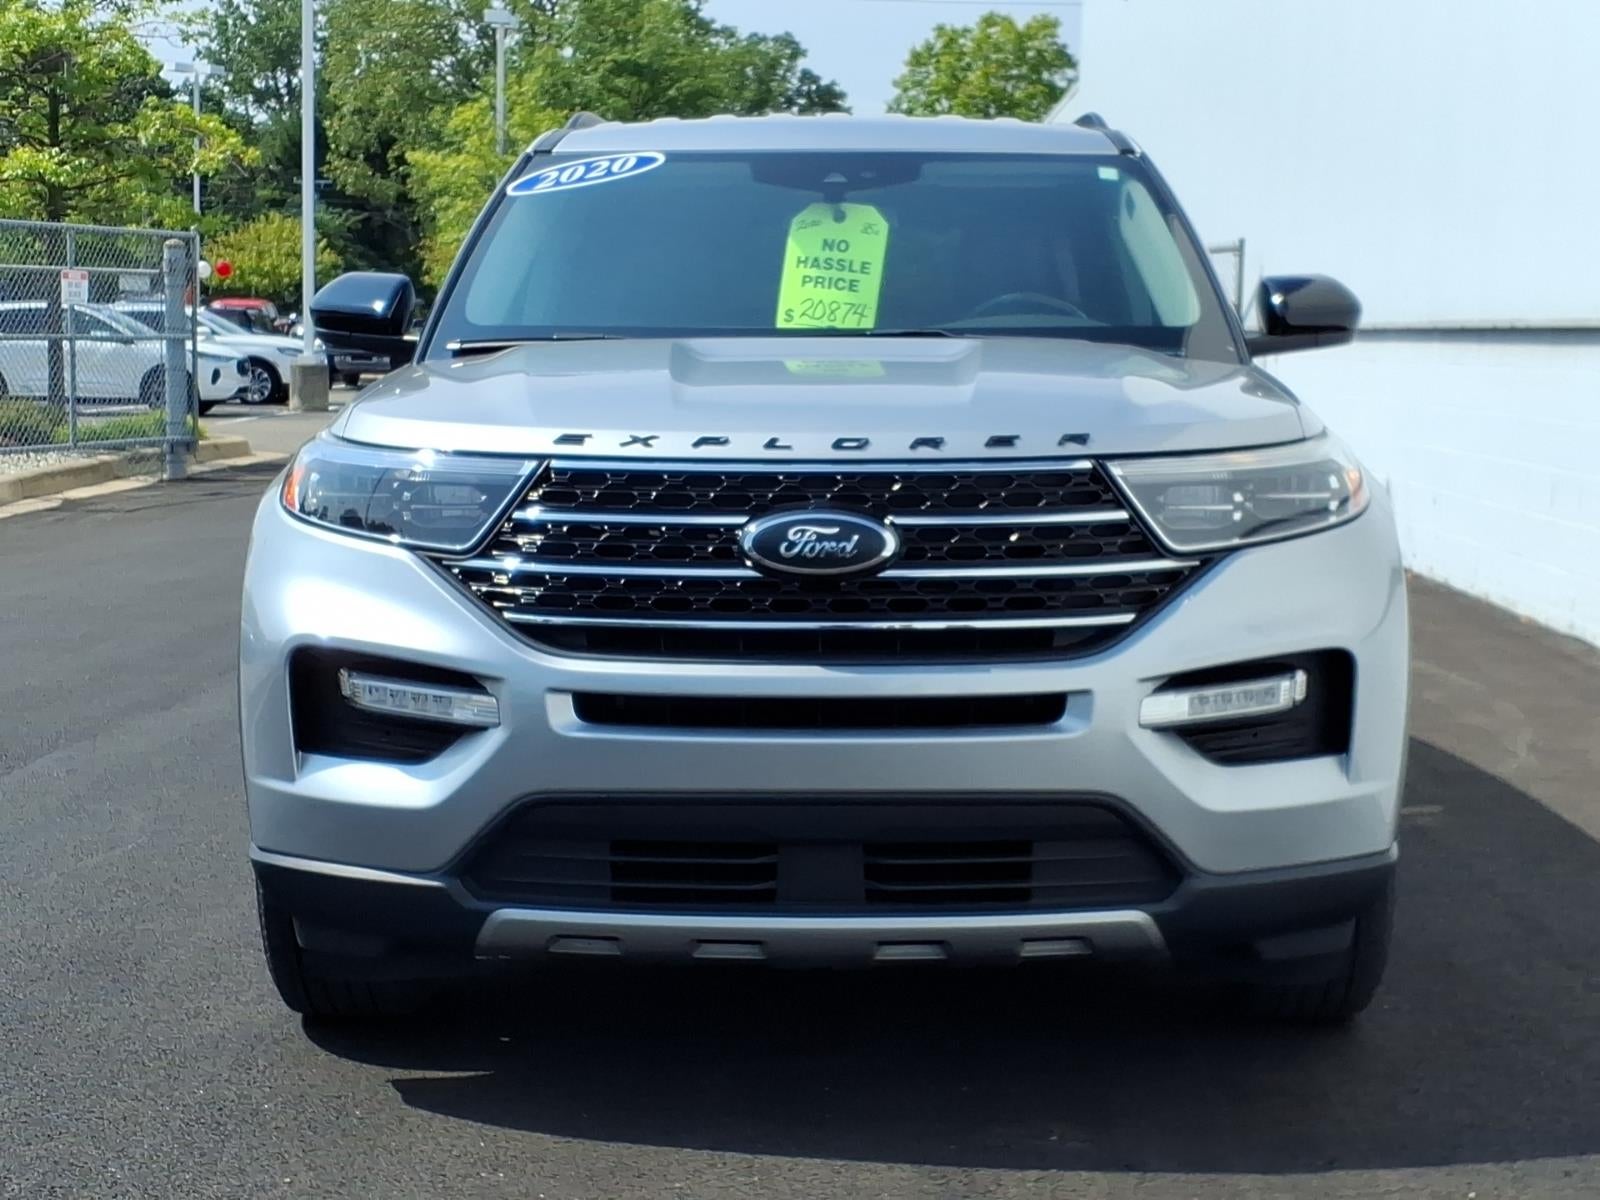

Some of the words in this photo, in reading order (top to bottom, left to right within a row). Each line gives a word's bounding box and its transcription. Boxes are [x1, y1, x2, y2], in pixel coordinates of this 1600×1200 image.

[533, 156, 638, 190] 2020
[822, 238, 850, 253] NO
[796, 255, 872, 275] HASSLE
[801, 274, 860, 293] PRICE
[552, 433, 1091, 450] EXPLORER
[780, 525, 859, 558] Ford
